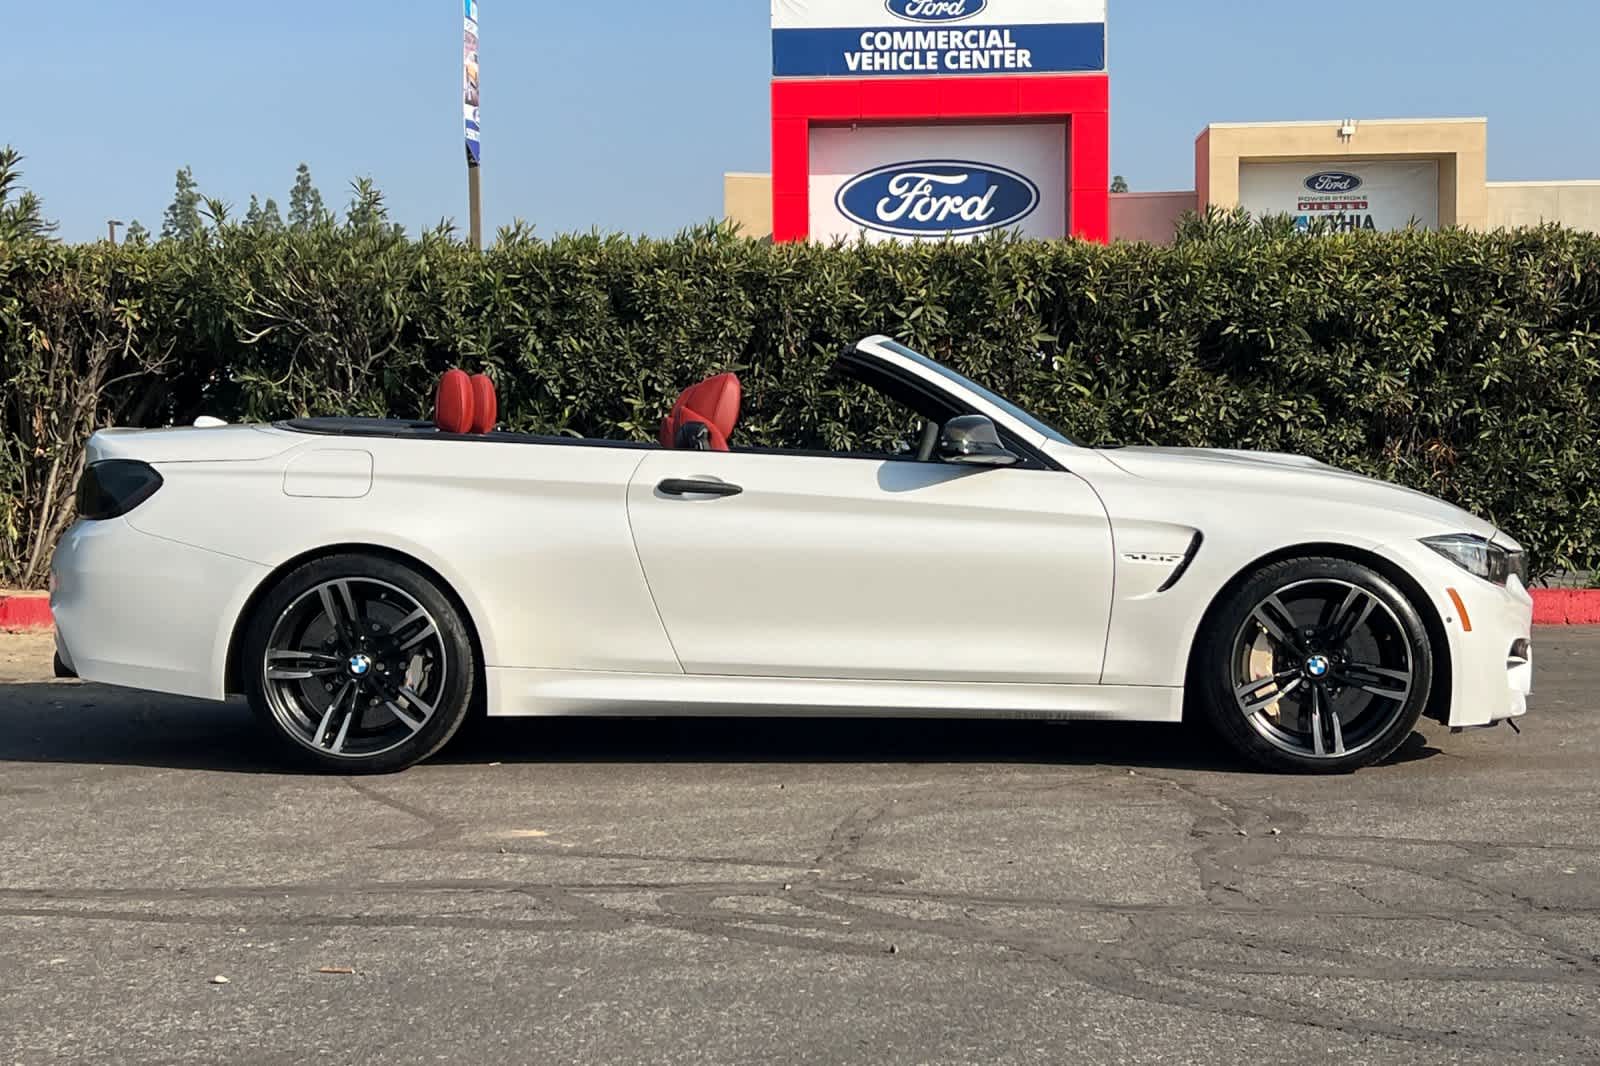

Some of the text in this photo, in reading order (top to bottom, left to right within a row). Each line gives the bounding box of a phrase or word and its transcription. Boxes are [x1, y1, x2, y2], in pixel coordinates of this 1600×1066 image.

[905, 0, 966, 16] Ford
[860, 29, 1016, 51] COMMERCIAL
[844, 49, 1032, 71] VEHICLE CENTER
[1314, 175, 1350, 190] Ford
[876, 172, 999, 222] Ford
